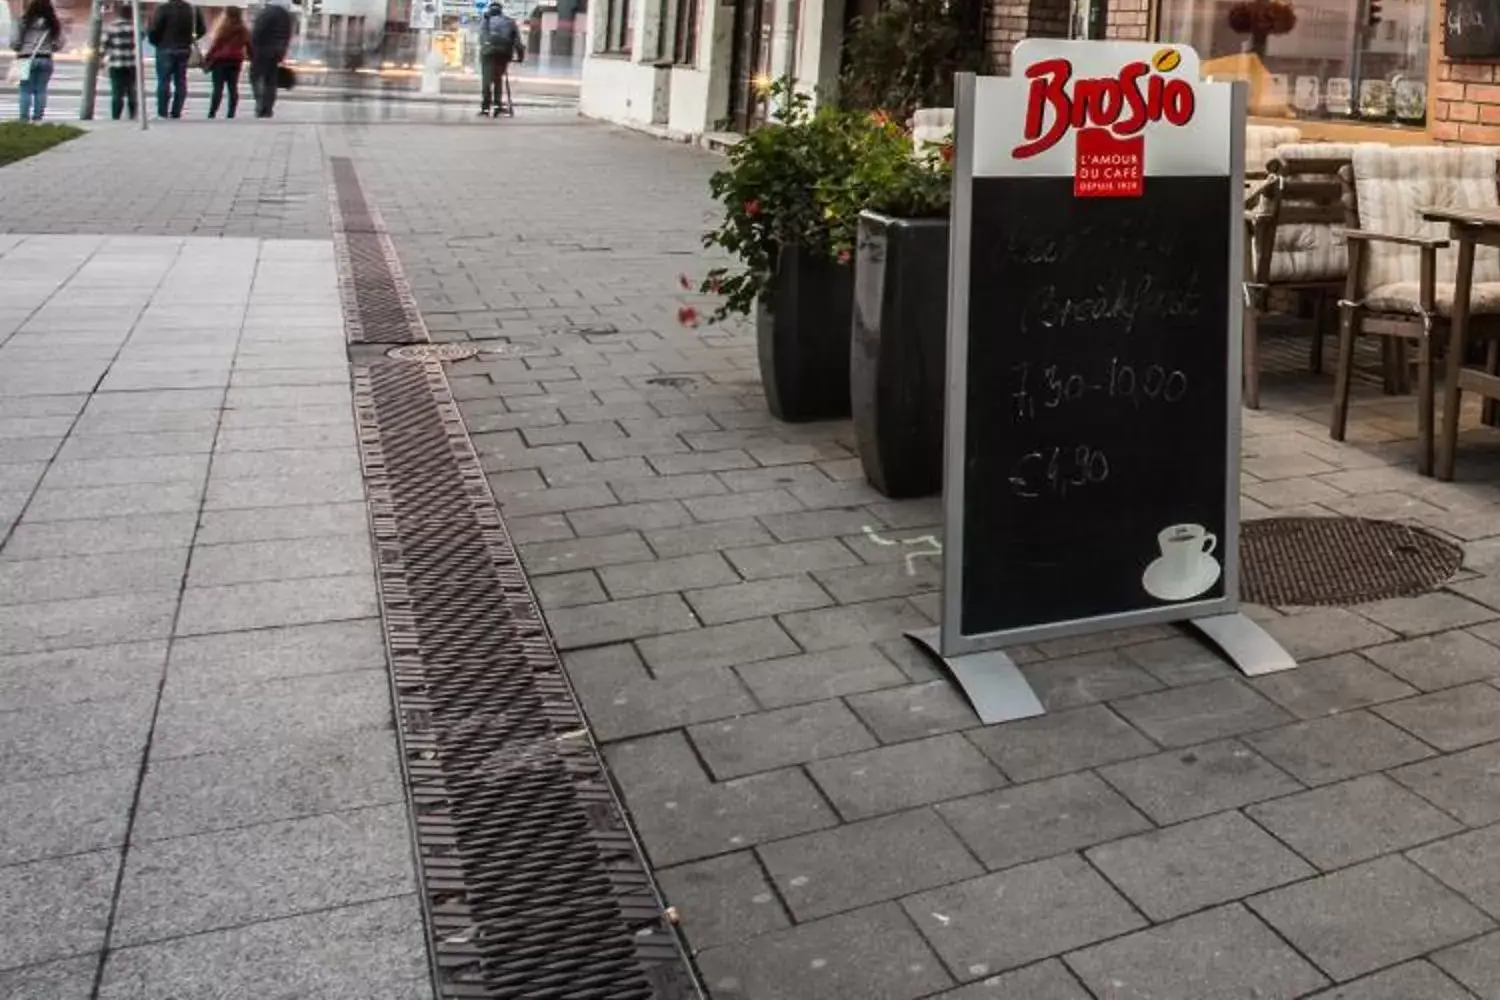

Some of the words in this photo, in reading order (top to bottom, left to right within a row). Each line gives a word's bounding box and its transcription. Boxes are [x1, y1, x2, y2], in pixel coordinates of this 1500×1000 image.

[1080, 153, 1138, 166] L'AMOUR
[1079, 167, 1100, 180] DU
[1103, 165, 1138, 179] CAFÉ
